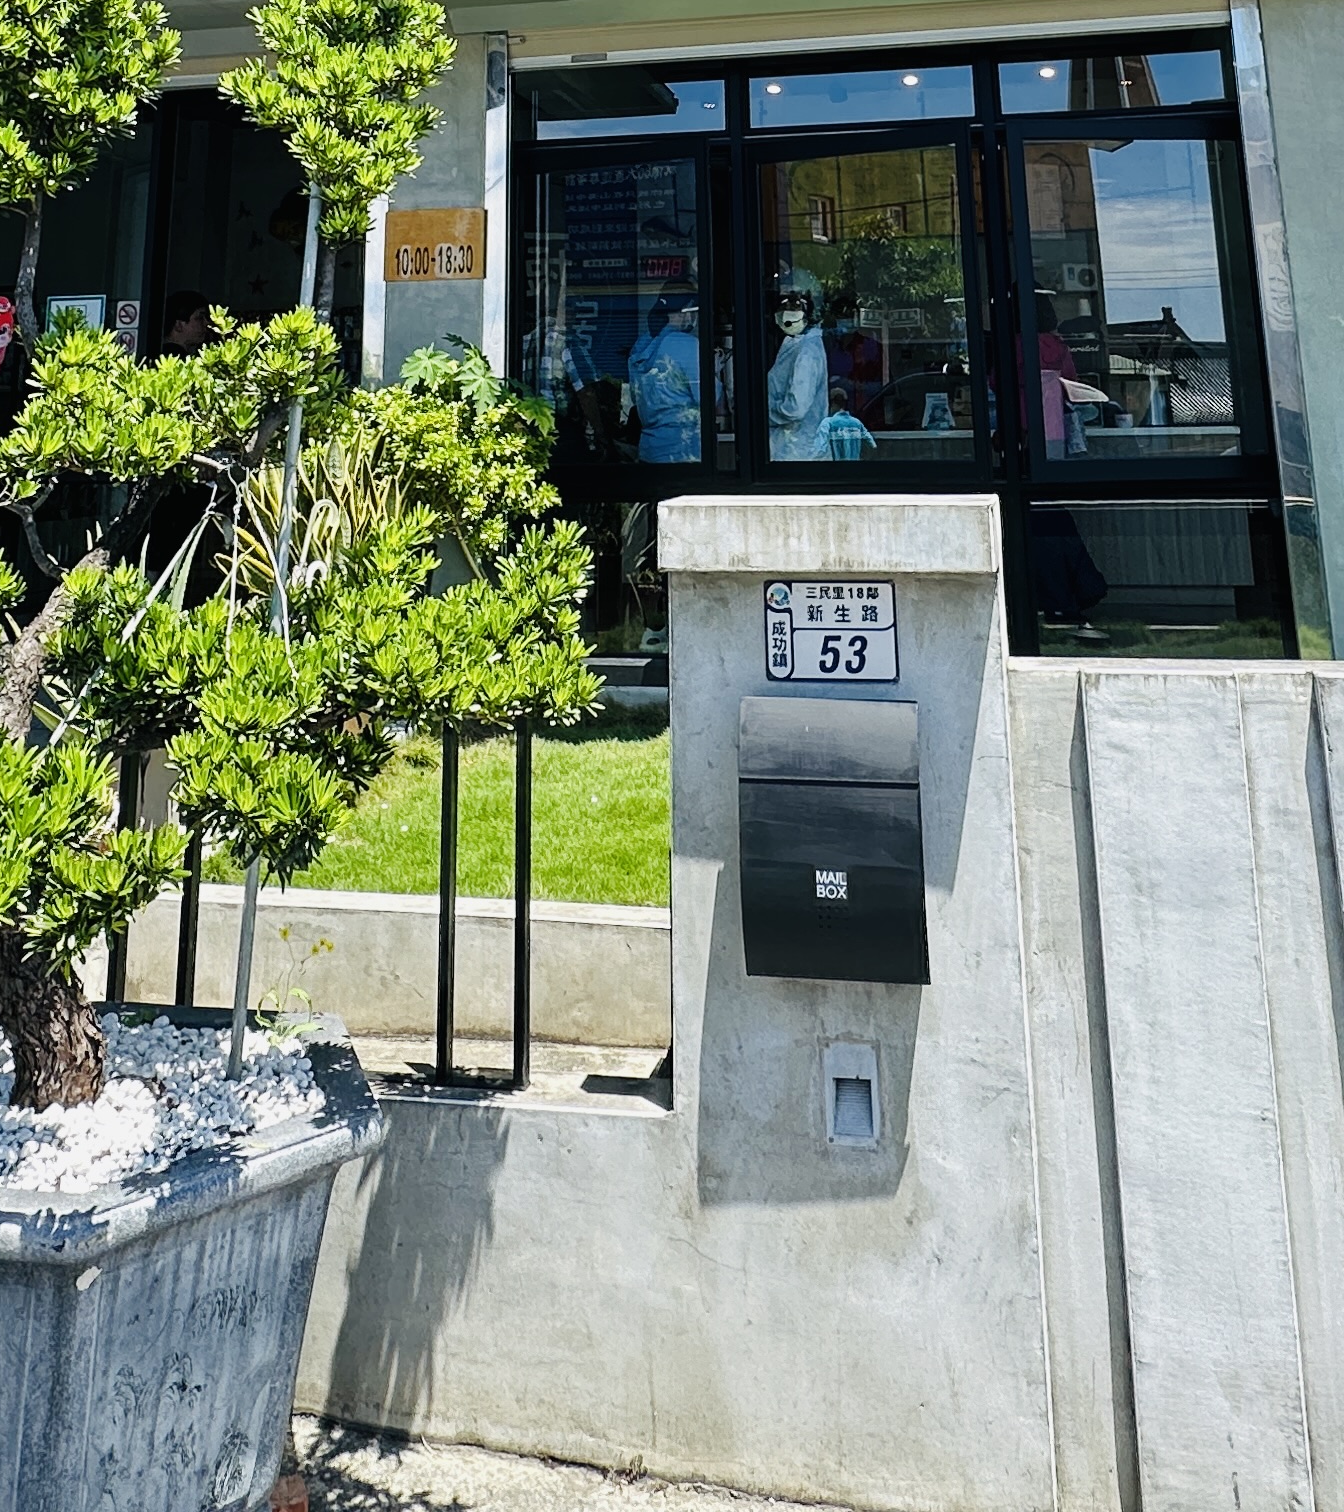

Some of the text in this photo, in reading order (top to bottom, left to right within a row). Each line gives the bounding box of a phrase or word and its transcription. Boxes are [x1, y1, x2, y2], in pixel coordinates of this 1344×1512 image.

[394, 244, 474, 276] 10:00-18:30
[805, 586, 879, 600] 三民里18鄰
[807, 603, 878, 623] 新生路
[771, 619, 788, 669] 成功鎮
[818, 634, 868, 675] 53
[816, 869, 848, 885] MAIL
[816, 884, 847, 899] BOX
